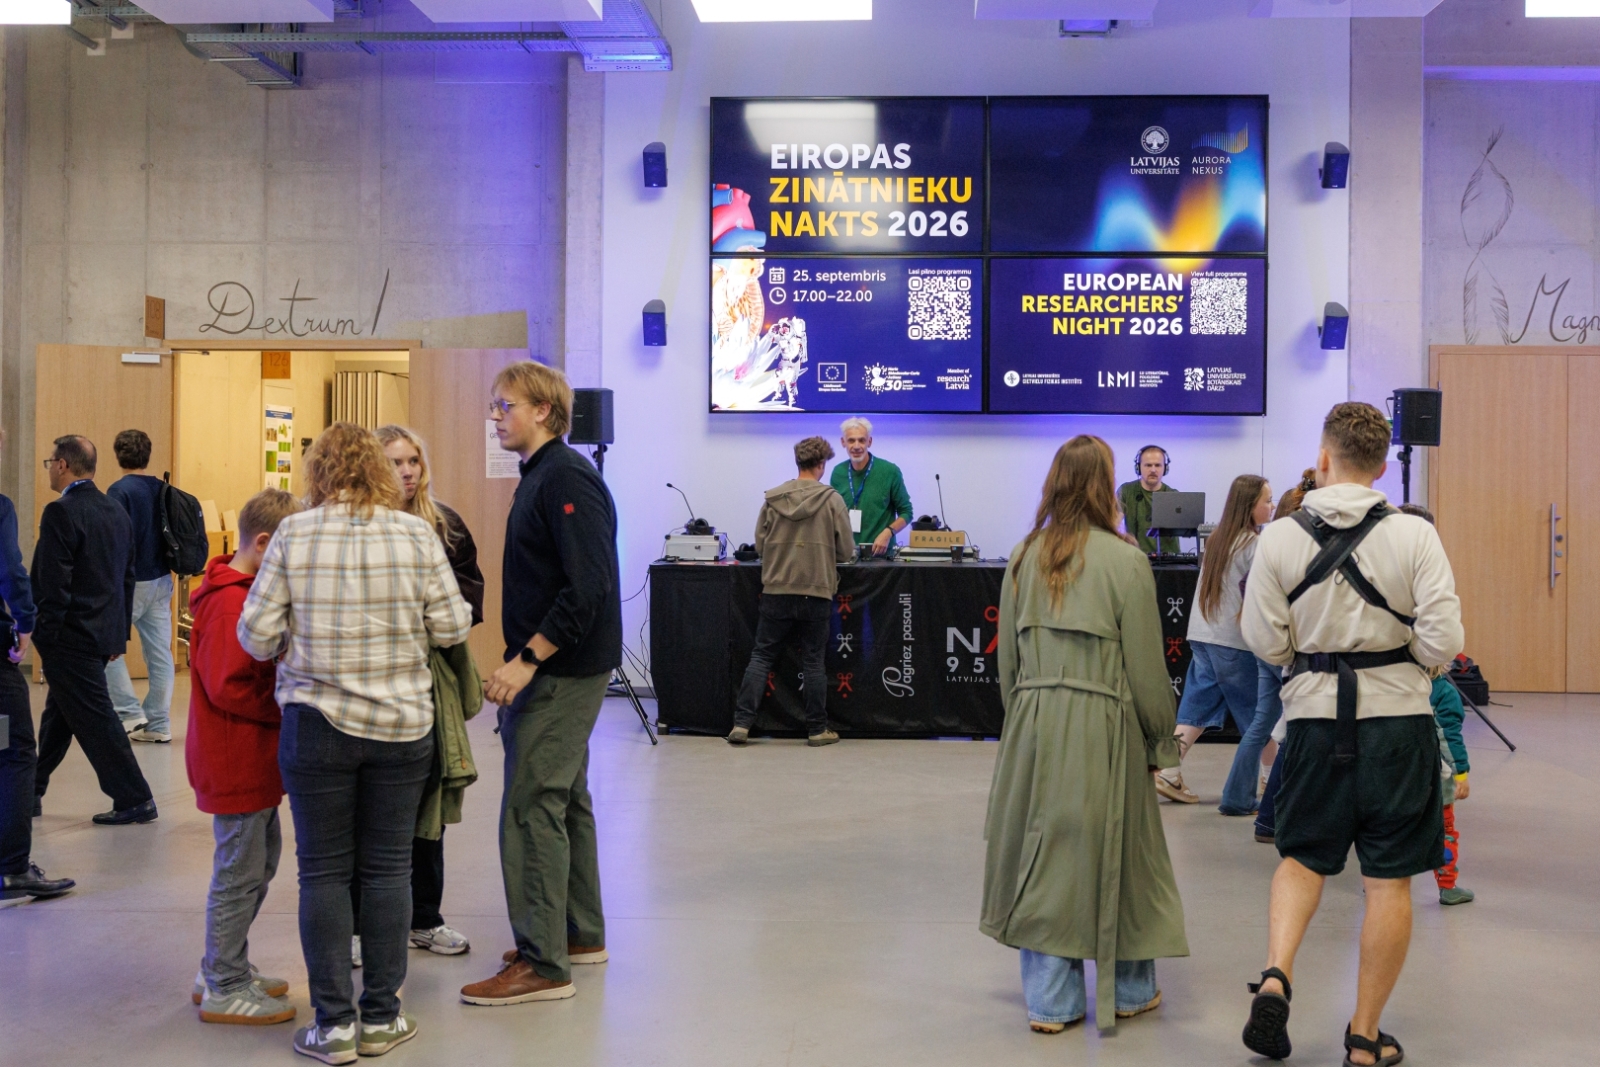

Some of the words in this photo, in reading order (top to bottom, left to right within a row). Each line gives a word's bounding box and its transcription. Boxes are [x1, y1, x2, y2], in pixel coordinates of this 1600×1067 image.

[770, 142, 912, 170] EIROPAS
[1130, 156, 1180, 168] LATVIJAS
[1191, 156, 1232, 164] AURORA
[1130, 167, 1180, 175] UNIVERSITĀTE
[1192, 166, 1224, 175] NEXUS
[769, 171, 972, 204] ZINĀTNIEKU
[770, 210, 879, 237] NAKTS
[888, 210, 969, 237] 2026
[793, 270, 812, 282] 25.
[815, 269, 887, 284] septembris
[1063, 273, 1183, 291] EUROPEAN
[1053, 317, 1125, 335] NIGHT
[1129, 317, 1183, 335] 2026
[269, 352, 289, 367] 126
[885, 380, 902, 391] 30
[945, 382, 970, 390] Latvia
[914, 535, 960, 543] FRAGILE
[881, 645, 915, 698] Pagriez
[899, 593, 915, 641] pasauli!
[946, 675, 990, 684] LATVIJAS
